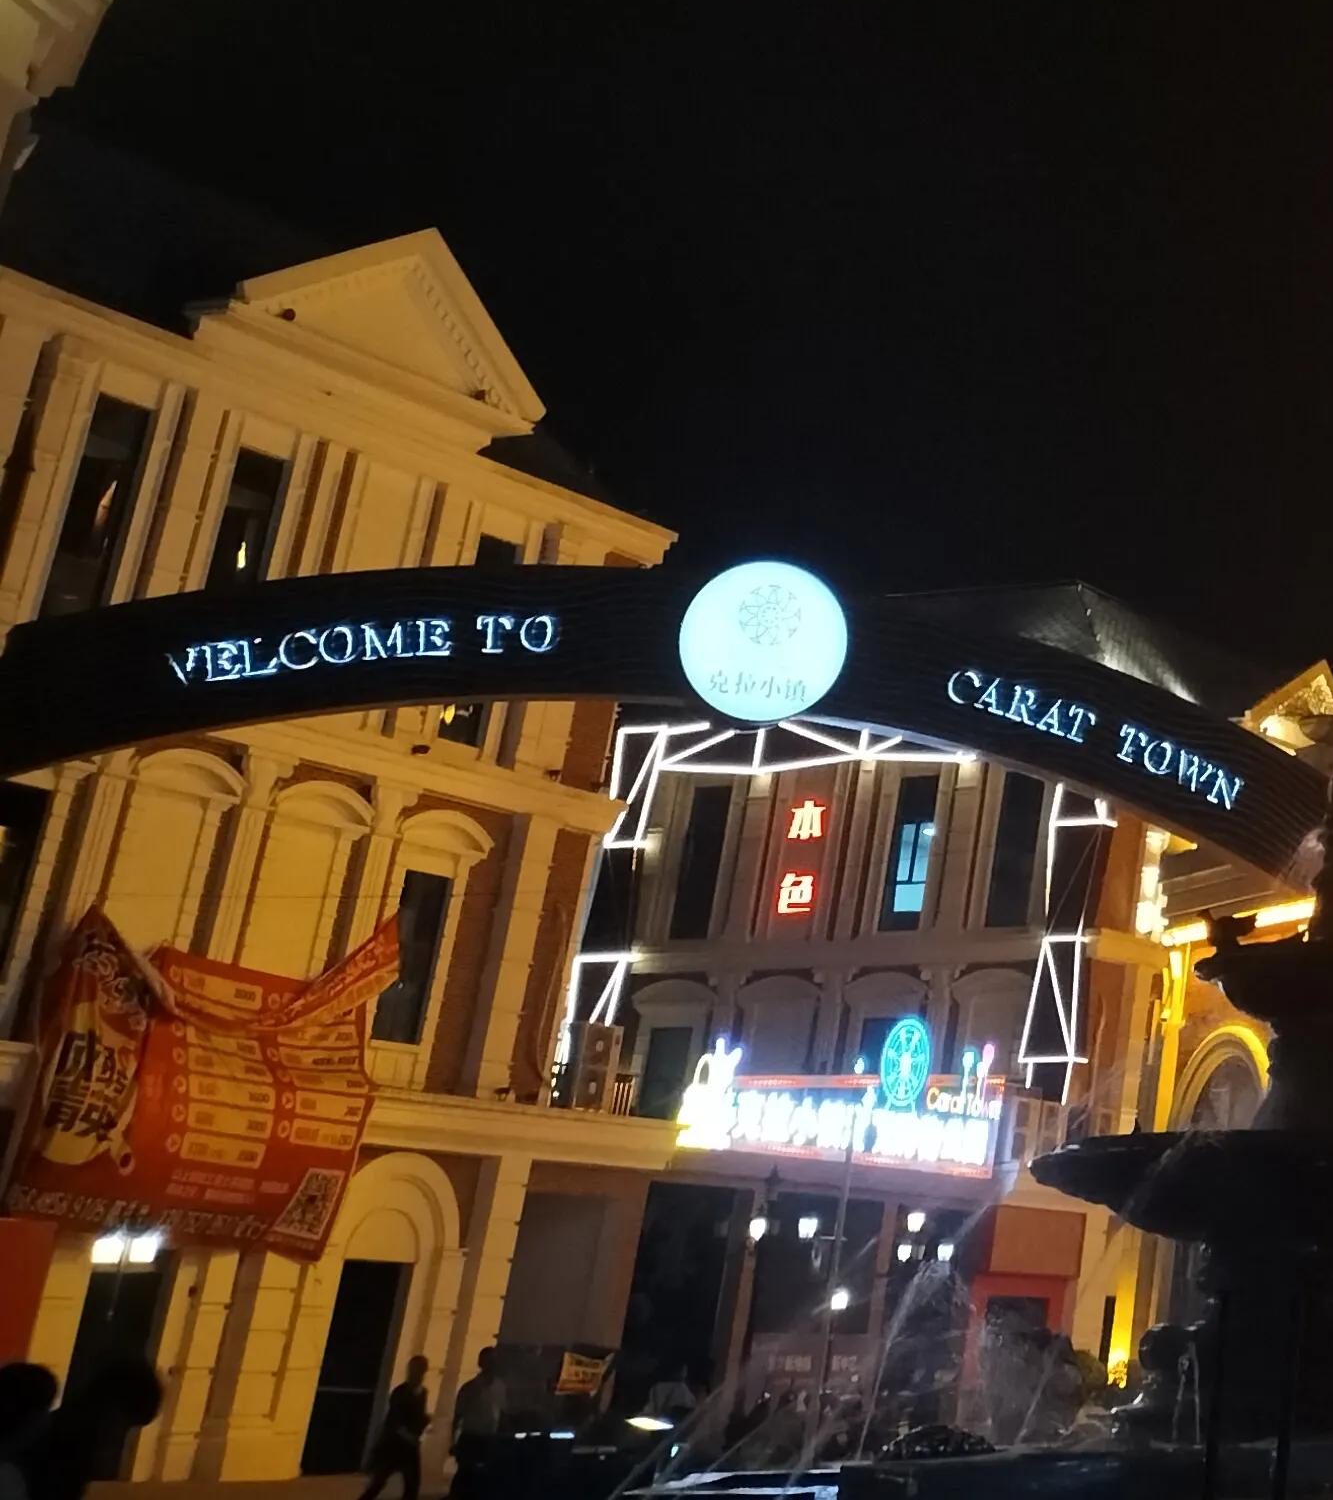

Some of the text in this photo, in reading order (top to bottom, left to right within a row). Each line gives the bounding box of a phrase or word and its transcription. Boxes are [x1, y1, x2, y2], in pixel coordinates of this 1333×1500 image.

[475, 614, 562, 656] TO
[709, 670, 808, 703] 克拉小镇
[946, 669, 1246, 811] CARAT TOWN
[777, 799, 827, 914] 本色
